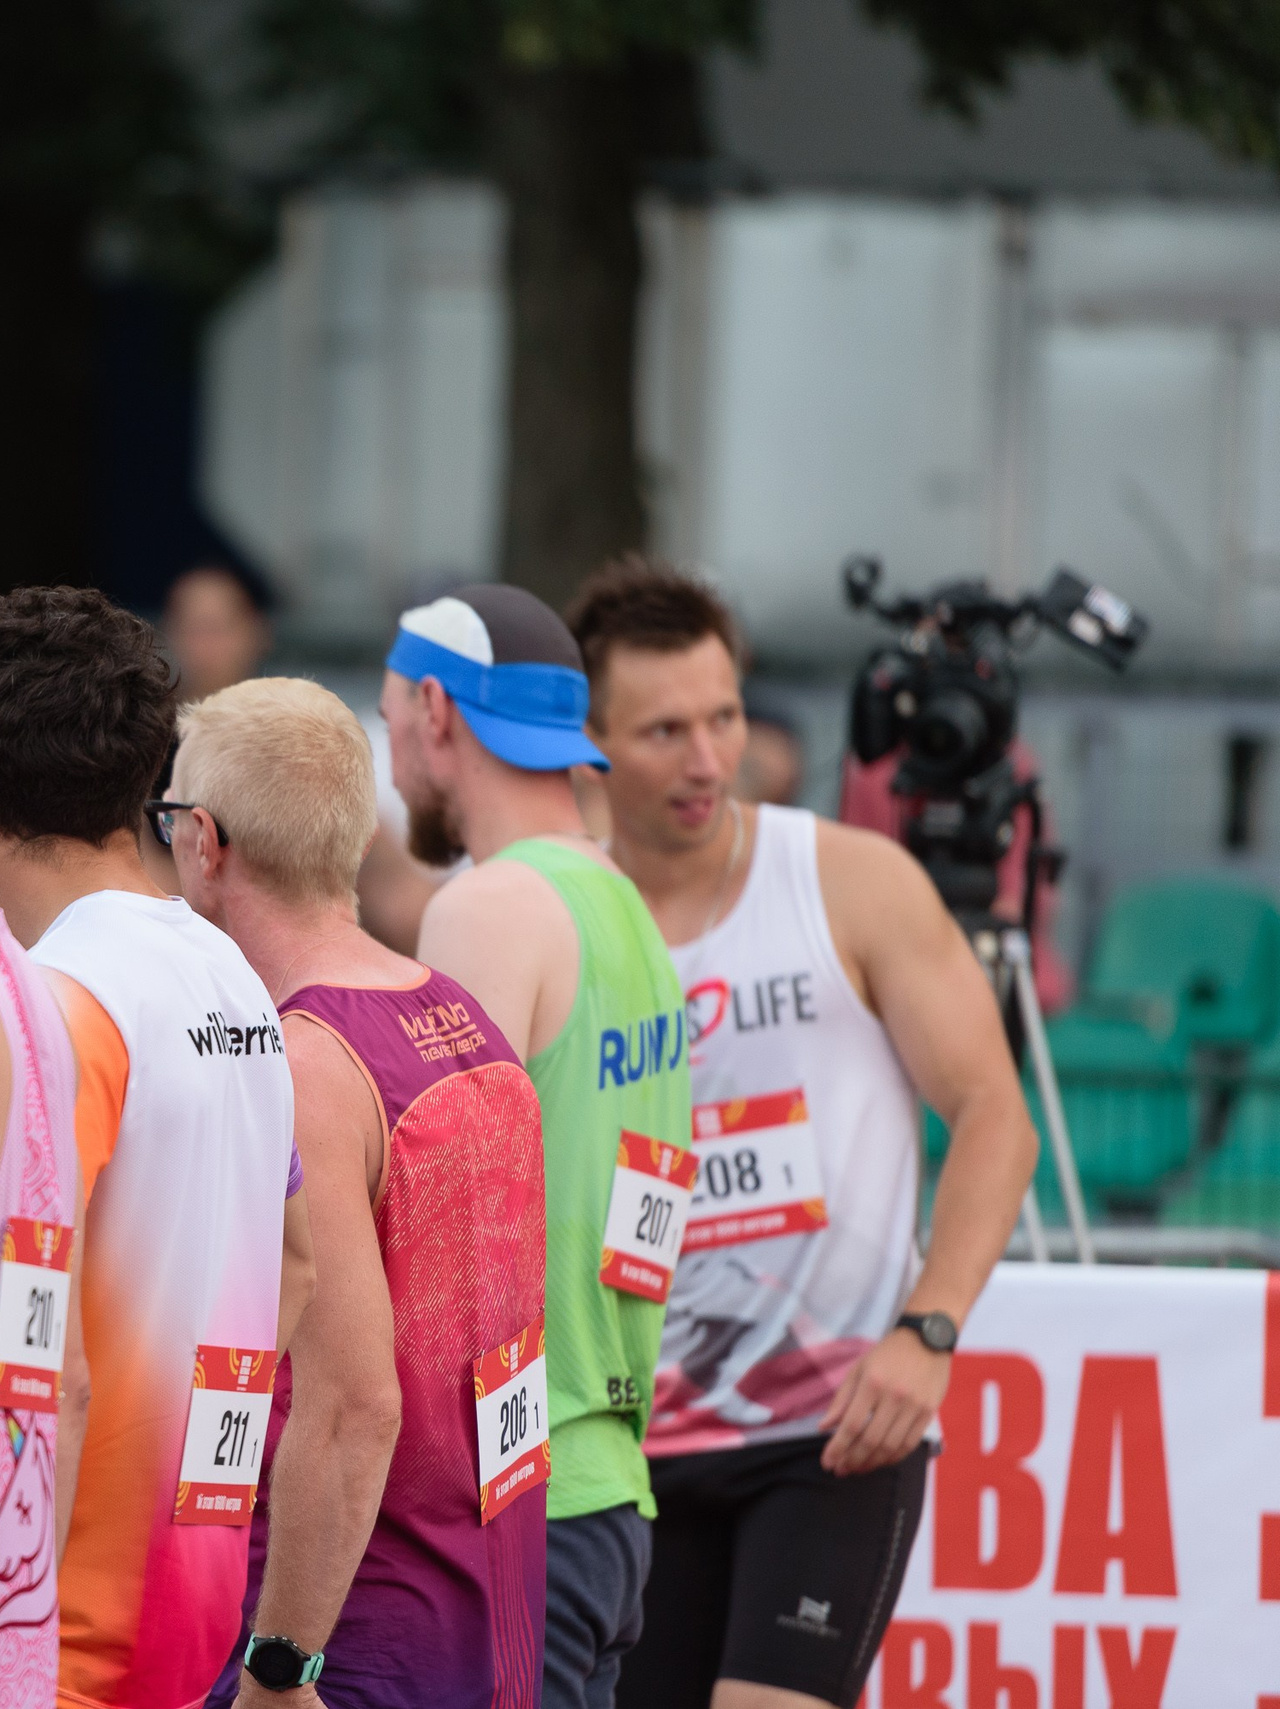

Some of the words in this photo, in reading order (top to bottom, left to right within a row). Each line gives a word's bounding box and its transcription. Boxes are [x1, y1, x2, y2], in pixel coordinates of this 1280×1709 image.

[731, 972, 817, 1035] LIFE
[691, 1147, 762, 1204] 08
[635, 1192, 674, 1248] 207
[607, 1376, 641, 1405] BE
[214, 1410, 250, 1467] 211
[251, 1438, 258, 1468] 1
[500, 1386, 527, 1456] 206
[534, 1401, 540, 1430] 1
[854, 1618, 1178, 1709] ВЫХ
